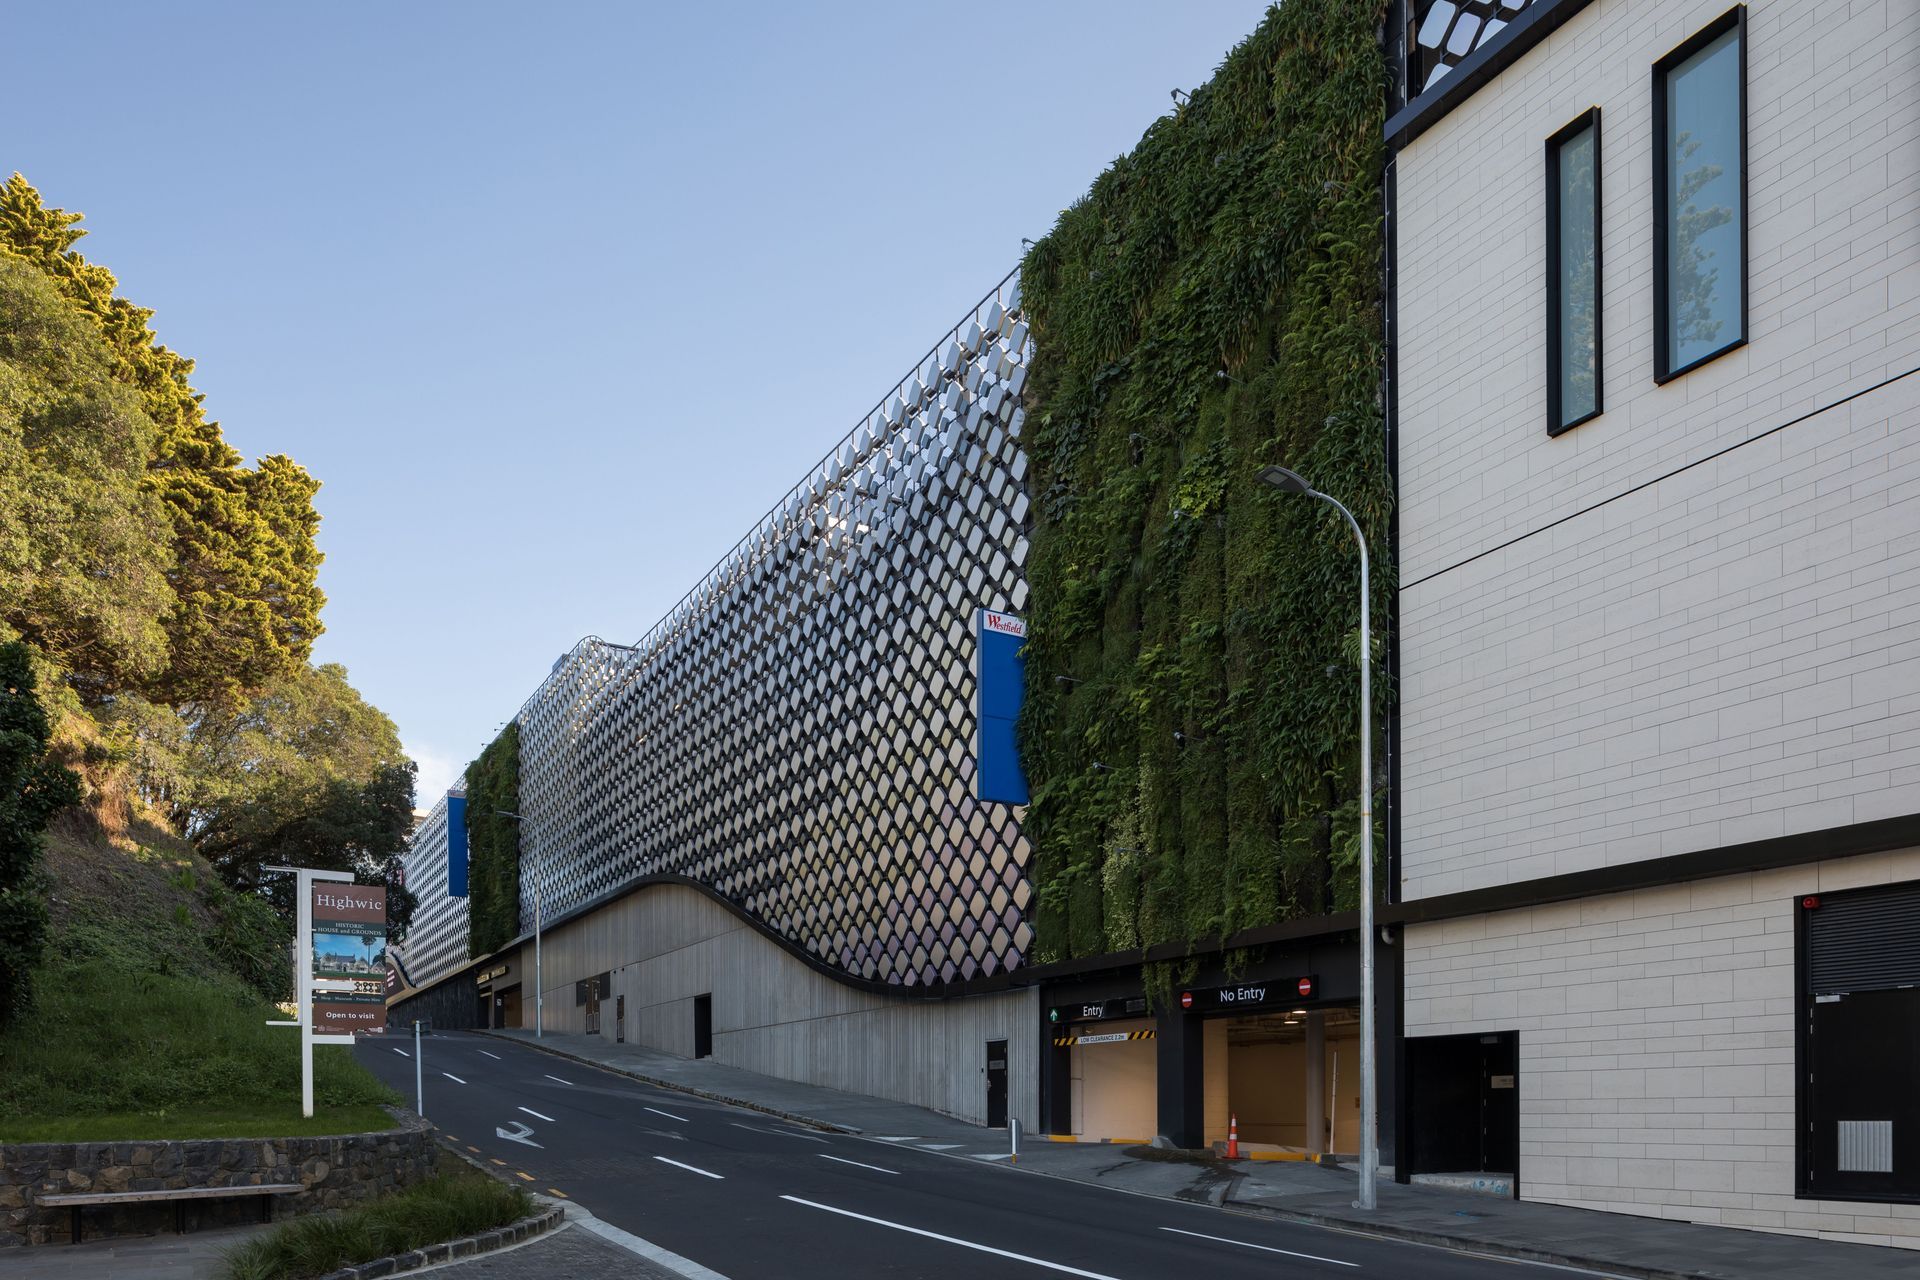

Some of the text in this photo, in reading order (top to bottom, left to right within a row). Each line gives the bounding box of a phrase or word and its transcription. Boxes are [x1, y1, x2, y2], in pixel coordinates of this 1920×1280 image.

[987, 613, 1022, 634] Westfield
[317, 894, 382, 910] Highwic
[351, 928, 382, 936] GROUNDS
[1220, 988, 1266, 1002] No Entry
[326, 1011, 346, 1019] Open
[1083, 1005, 1104, 1018] Entry
